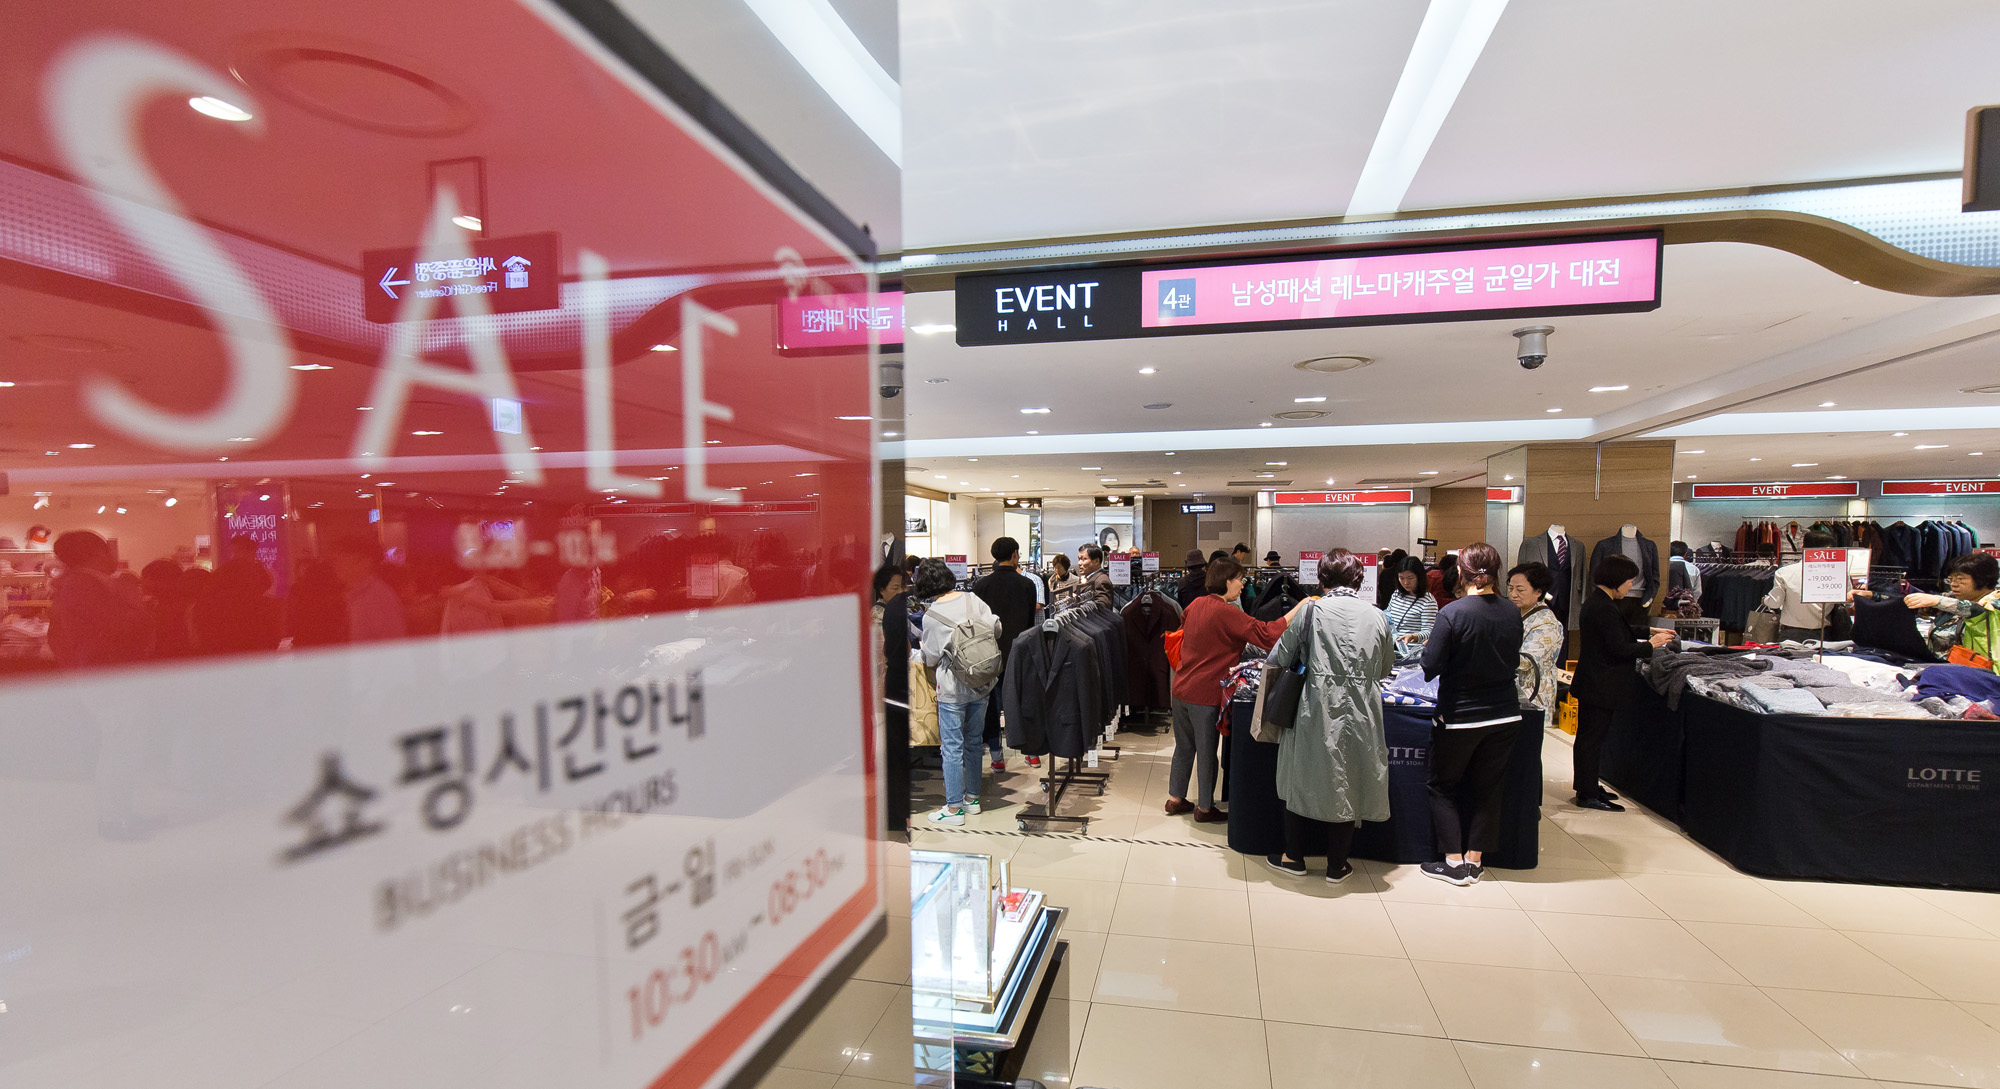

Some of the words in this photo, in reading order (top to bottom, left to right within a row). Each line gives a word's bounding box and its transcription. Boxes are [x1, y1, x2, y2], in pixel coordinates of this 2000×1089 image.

[43, 33, 744, 504] SALE
[1231, 276, 1322, 307] 남성패션
[1328, 265, 1476, 302] 레노마캐주얼
[1482, 258, 1561, 291] 균일가
[1568, 257, 1621, 287] 대전
[995, 282, 1100, 314] EVENT
[1162, 286, 1192, 310] 4관
[997, 314, 1094, 332] HALL
[1752, 485, 1788, 495] EVENT
[1945, 482, 1986, 492] EVENT
[1325, 493, 1357, 502] EVENT
[1813, 551, 1837, 560] SALE
[1389, 746, 1426, 759] TTE
[273, 667, 706, 866] 쇼핑시간안내
[1907, 767, 1982, 783] LOTTE
[373, 813, 577, 932] BUSINESS
[578, 768, 680, 838] HOURS
